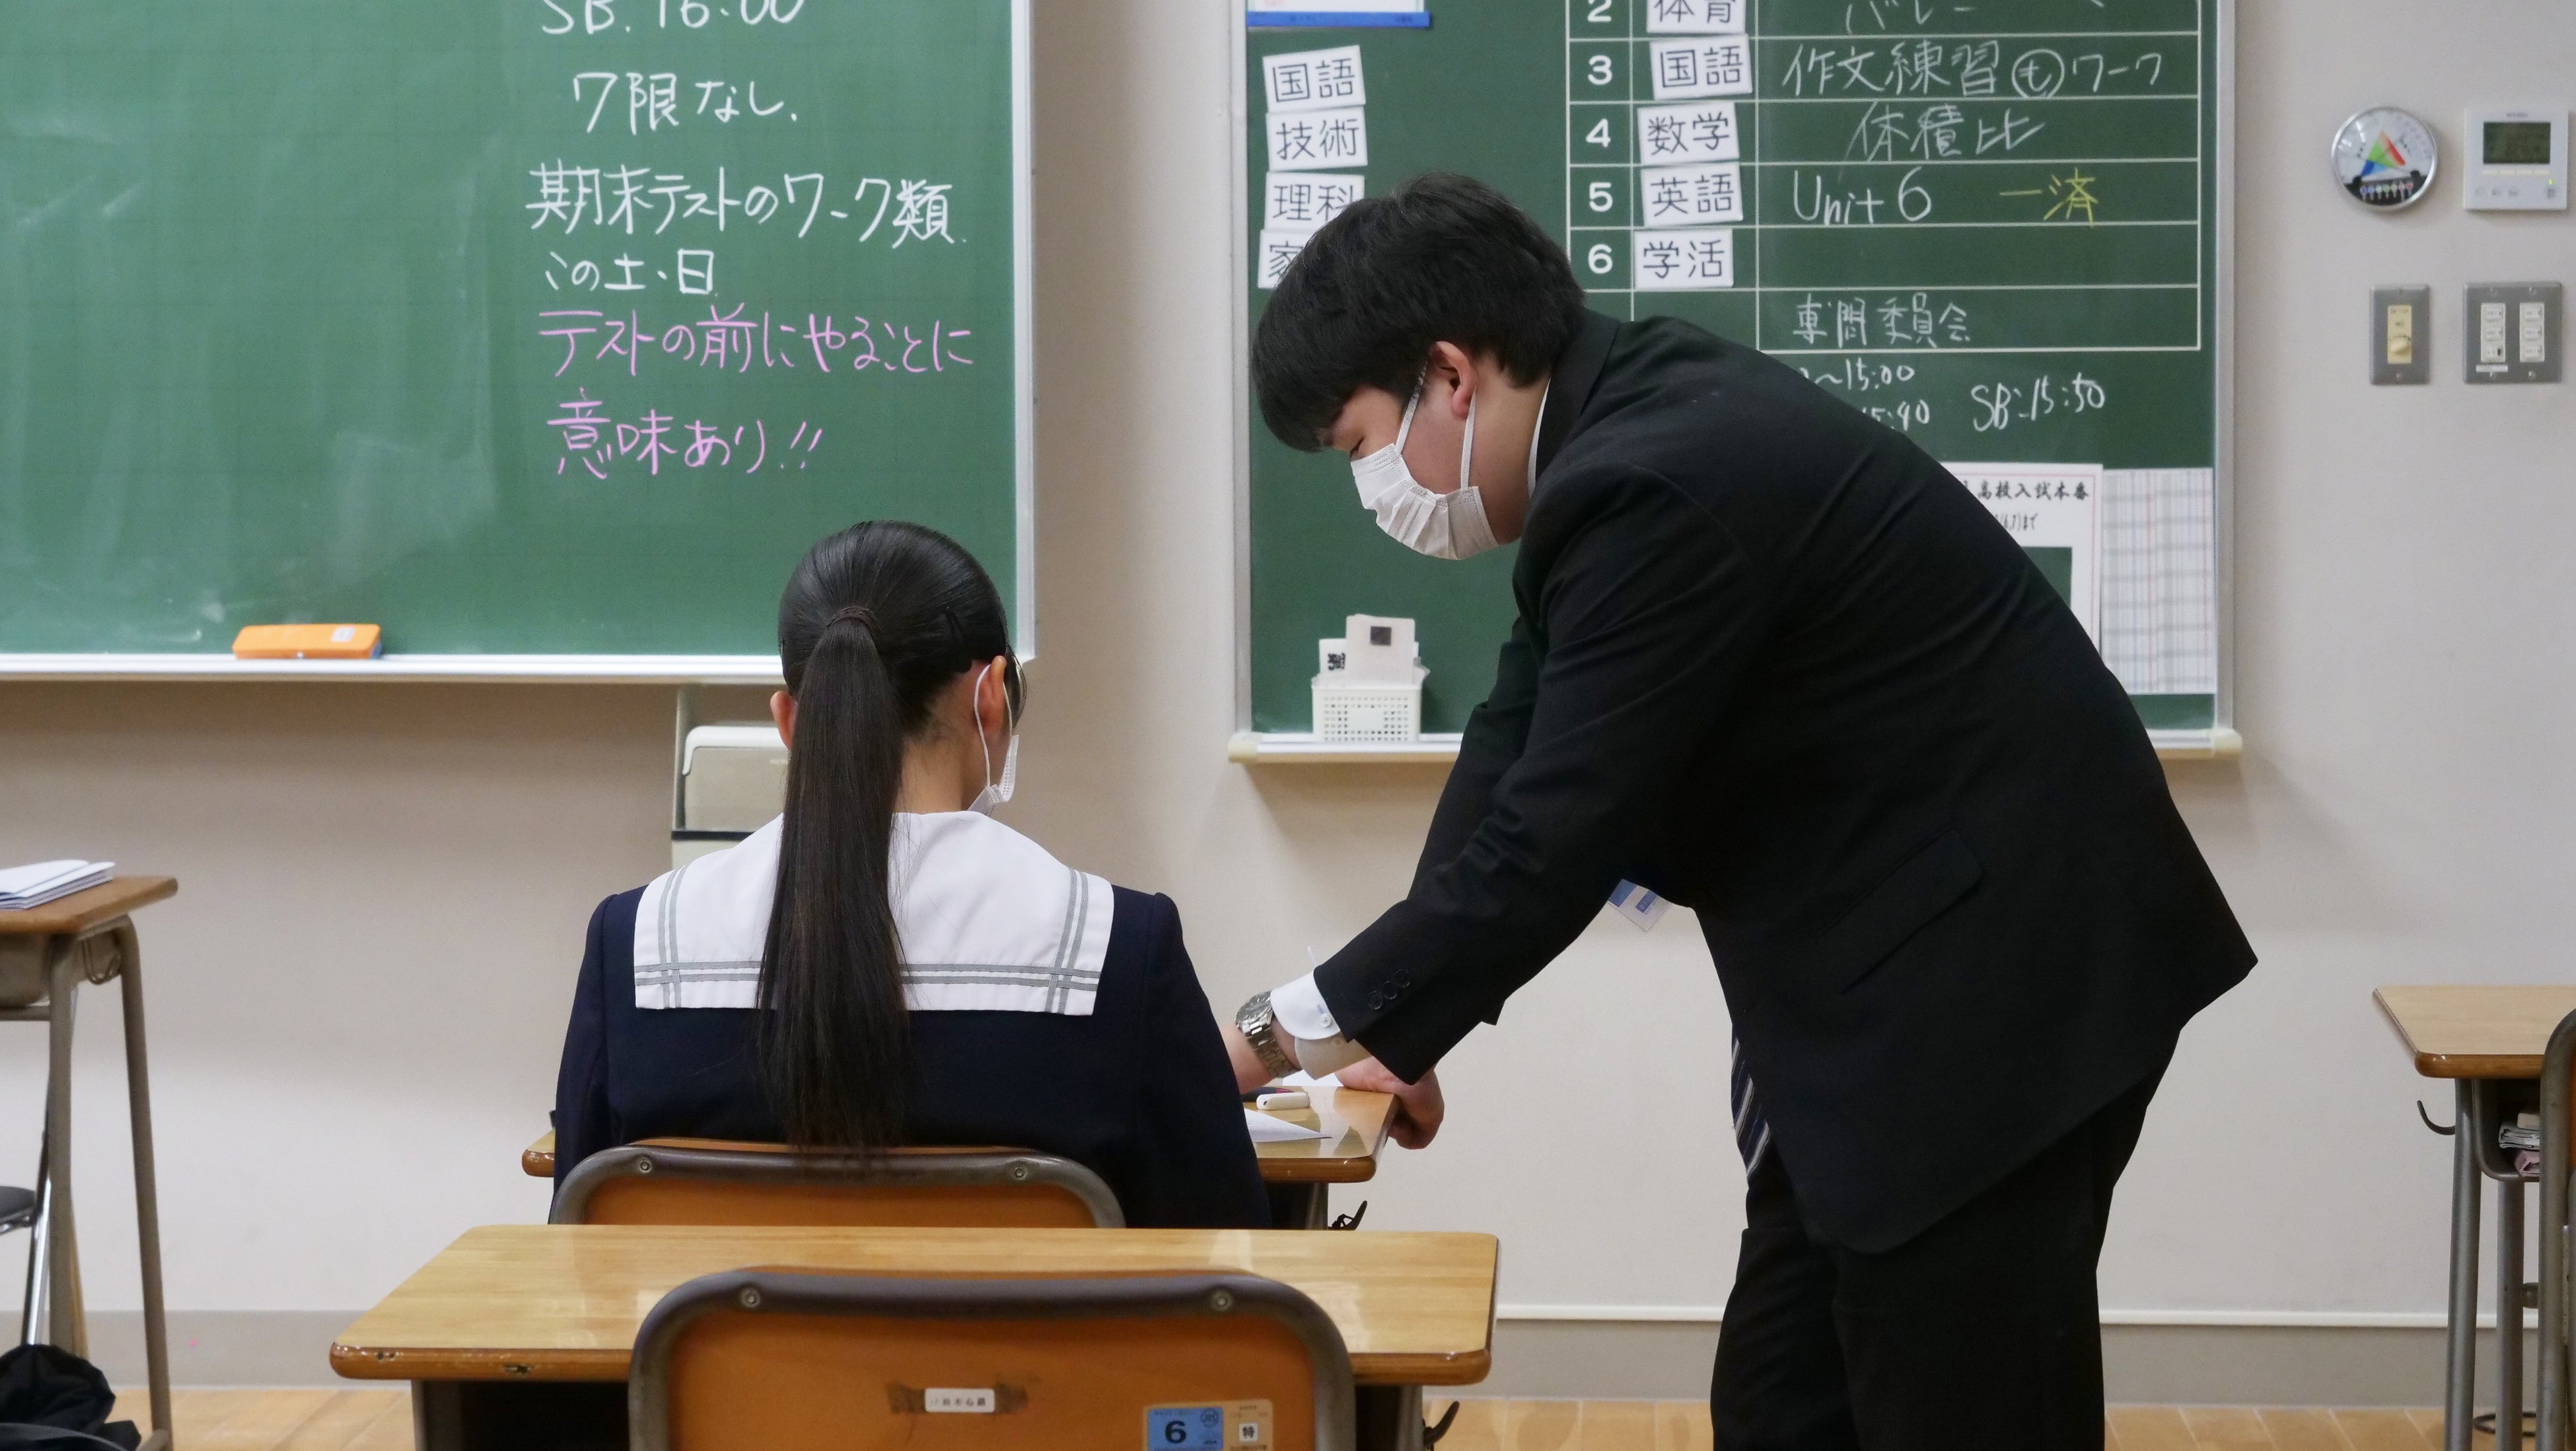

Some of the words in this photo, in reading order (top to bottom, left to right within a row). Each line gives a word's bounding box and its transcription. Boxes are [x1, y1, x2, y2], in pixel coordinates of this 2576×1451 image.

[1587, 0, 1612, 22] 2
[1272, 59, 1357, 103] 国語
[1588, 55, 1613, 85] 3
[1659, 46, 1744, 88] 国語
[1275, 118, 1359, 160] 技術
[1586, 119, 1611, 148] 4
[1647, 112, 1730, 155] 数学
[1845, 100, 2046, 162] 体積比
[1273, 184, 1353, 222] 理科
[1588, 183, 1612, 212] 5
[1652, 174, 1734, 217] 英語
[1793, 170, 1884, 226] Unit
[1898, 165, 1932, 222] 6
[1268, 240, 1304, 279] 家
[1588, 244, 1612, 274] 6
[1643, 241, 1725, 279] 学活
[538, 302, 974, 377] テストの前にやることに
[1962, 479, 2091, 501] 高校入試本番
[1165, 1421, 1187, 1444] 6
